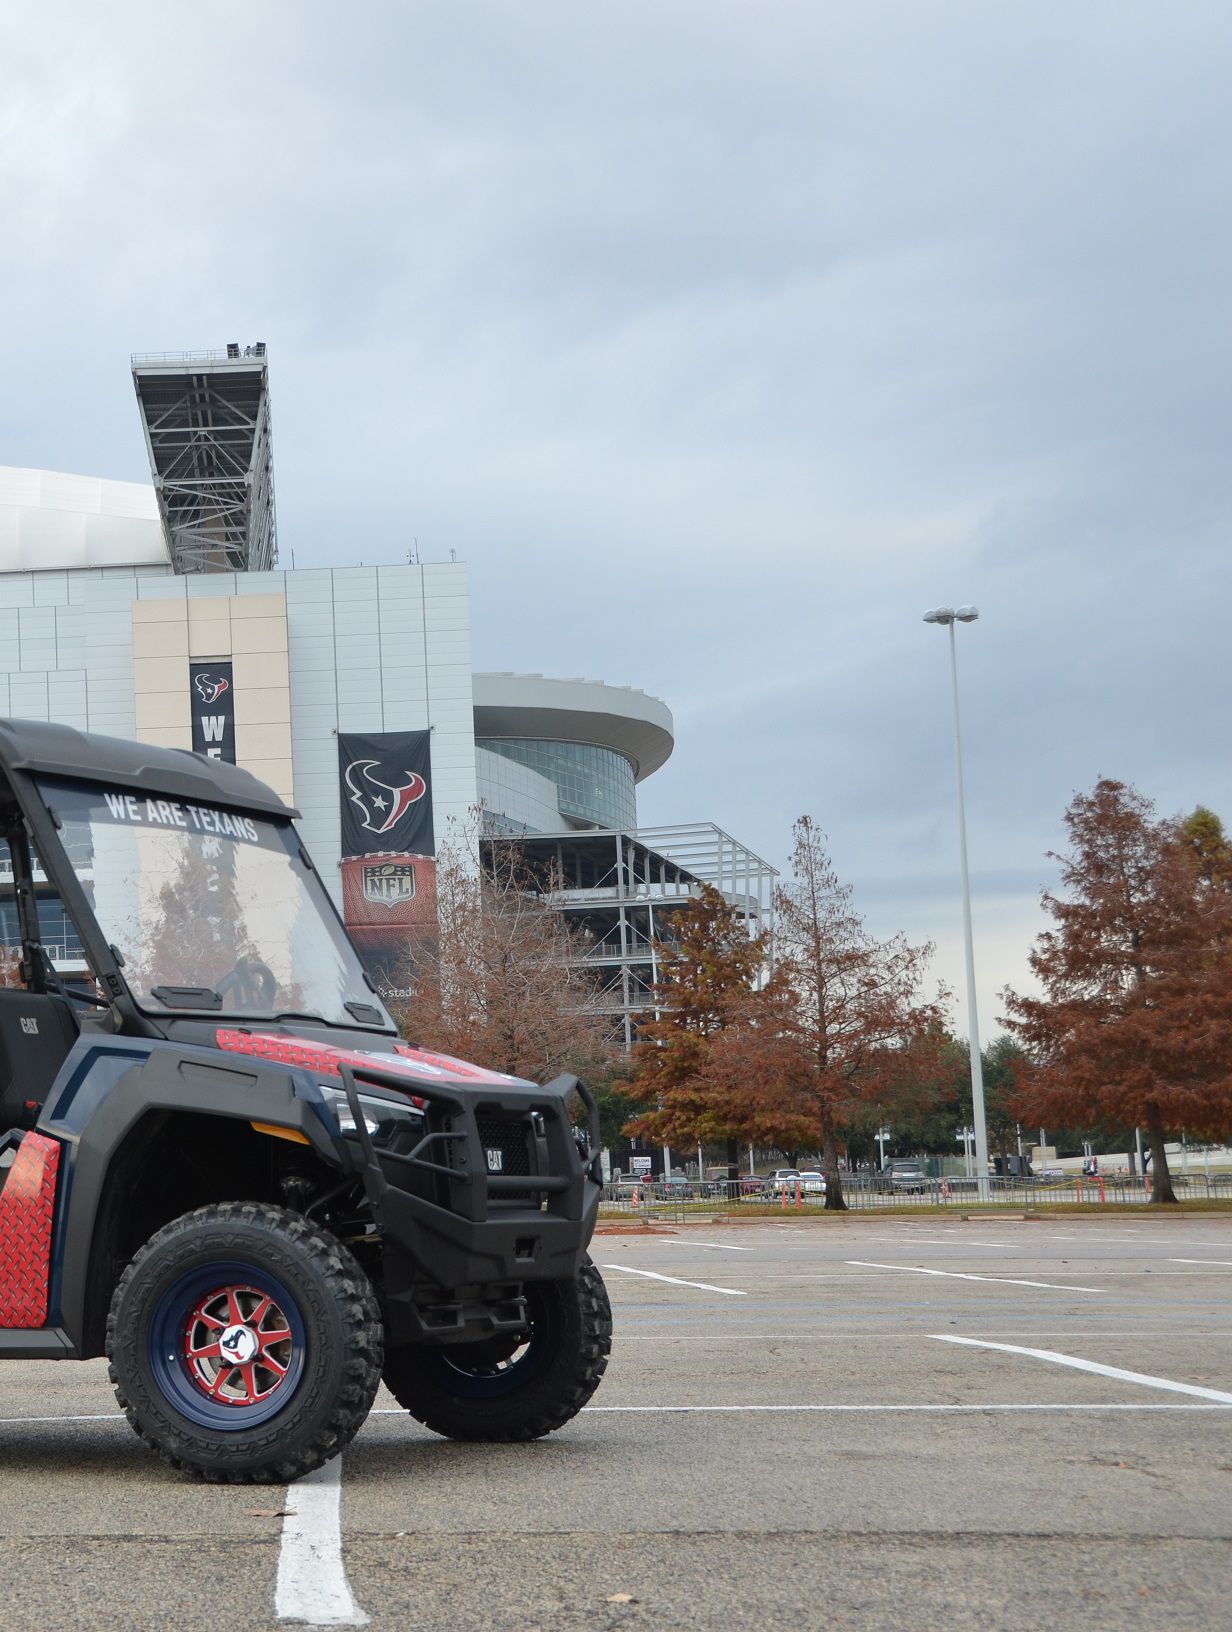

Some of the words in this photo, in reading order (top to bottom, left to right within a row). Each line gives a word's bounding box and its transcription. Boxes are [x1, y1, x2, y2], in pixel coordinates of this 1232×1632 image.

[104, 793, 142, 821] WE
[146, 799, 187, 827] ARE
[186, 805, 259, 842] TEXANS
[368, 877, 410, 899] NFL
[20, 1017, 39, 1034] CAT
[487, 1150, 502, 1170] CAT
